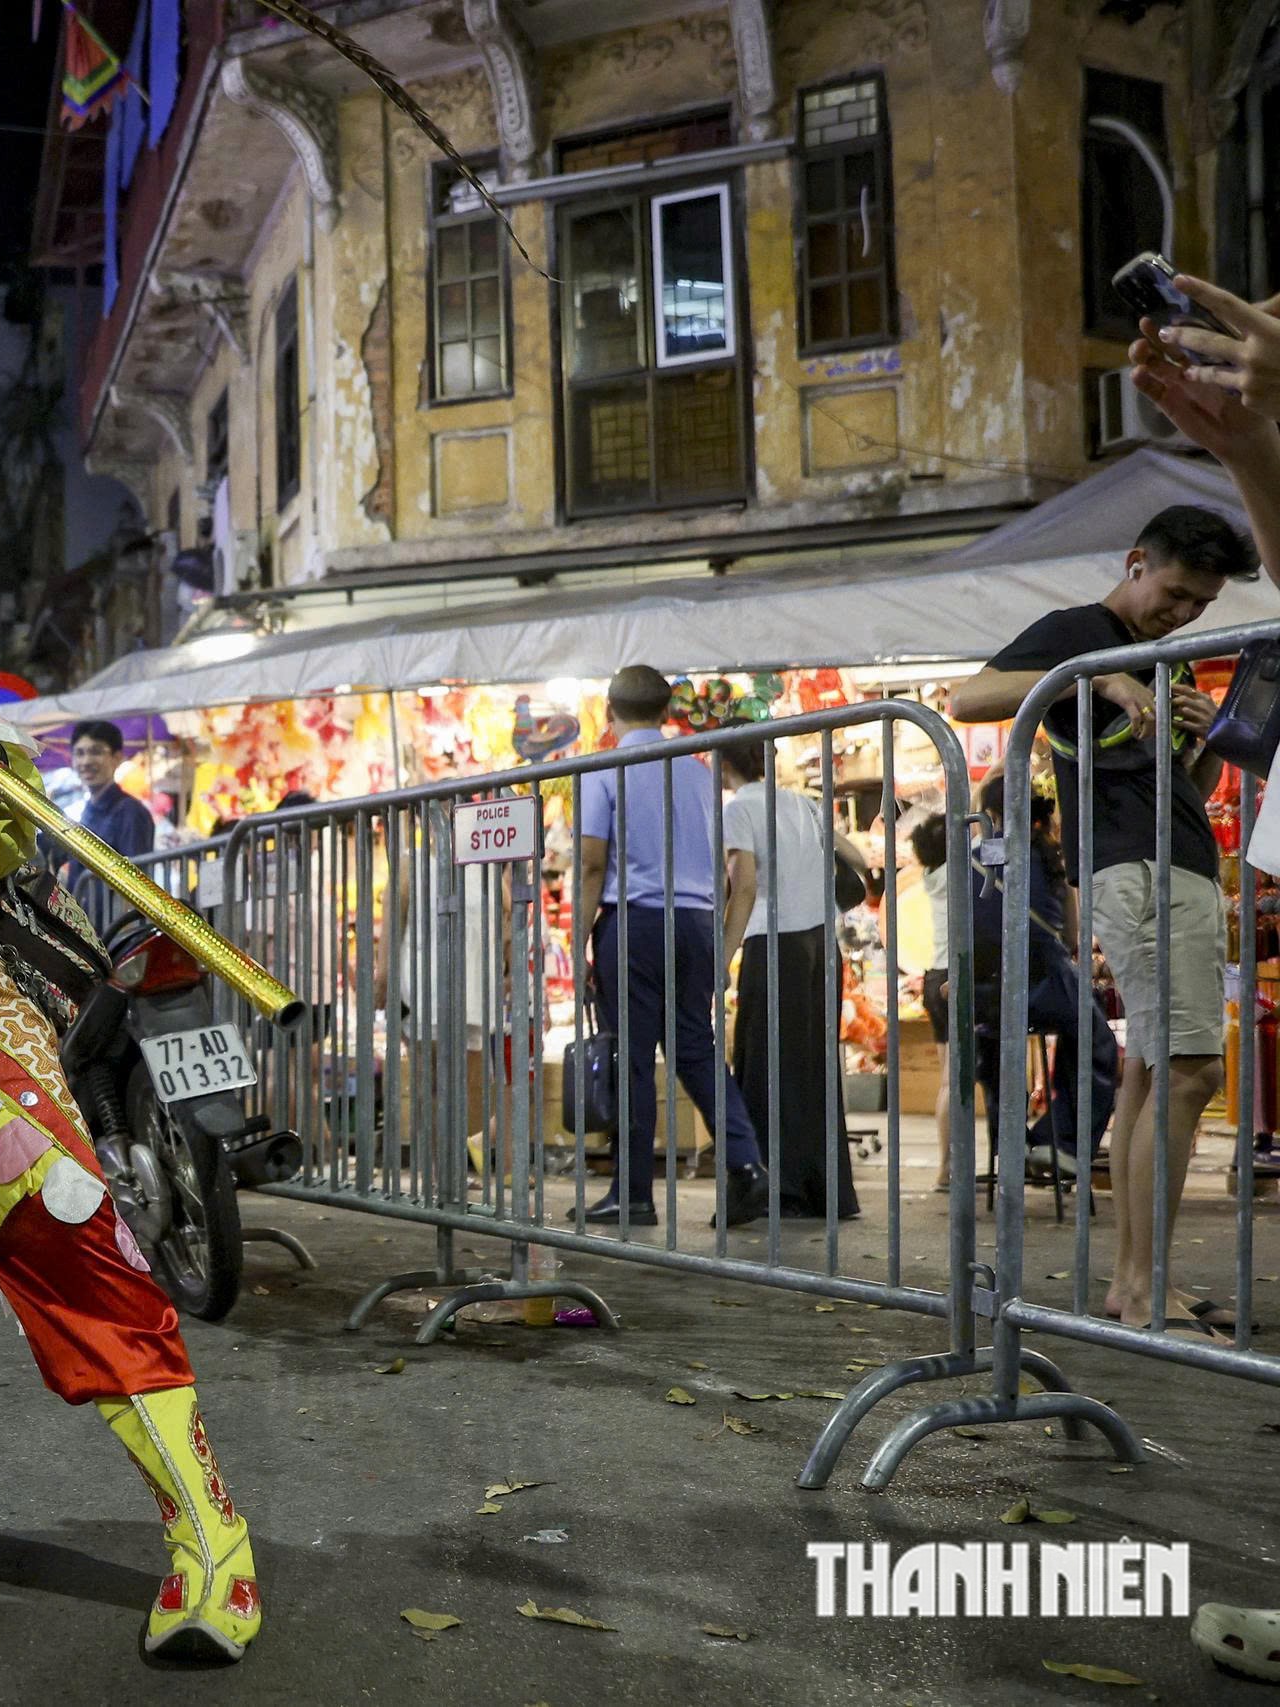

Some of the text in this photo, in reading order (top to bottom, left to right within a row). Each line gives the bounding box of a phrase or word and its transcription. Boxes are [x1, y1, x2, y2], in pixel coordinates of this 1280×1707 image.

[477, 806, 510, 821] POLICE
[470, 826, 517, 850] STOP
[157, 1029, 229, 1065] 77-AD
[158, 1055, 249, 1096] 013.32
